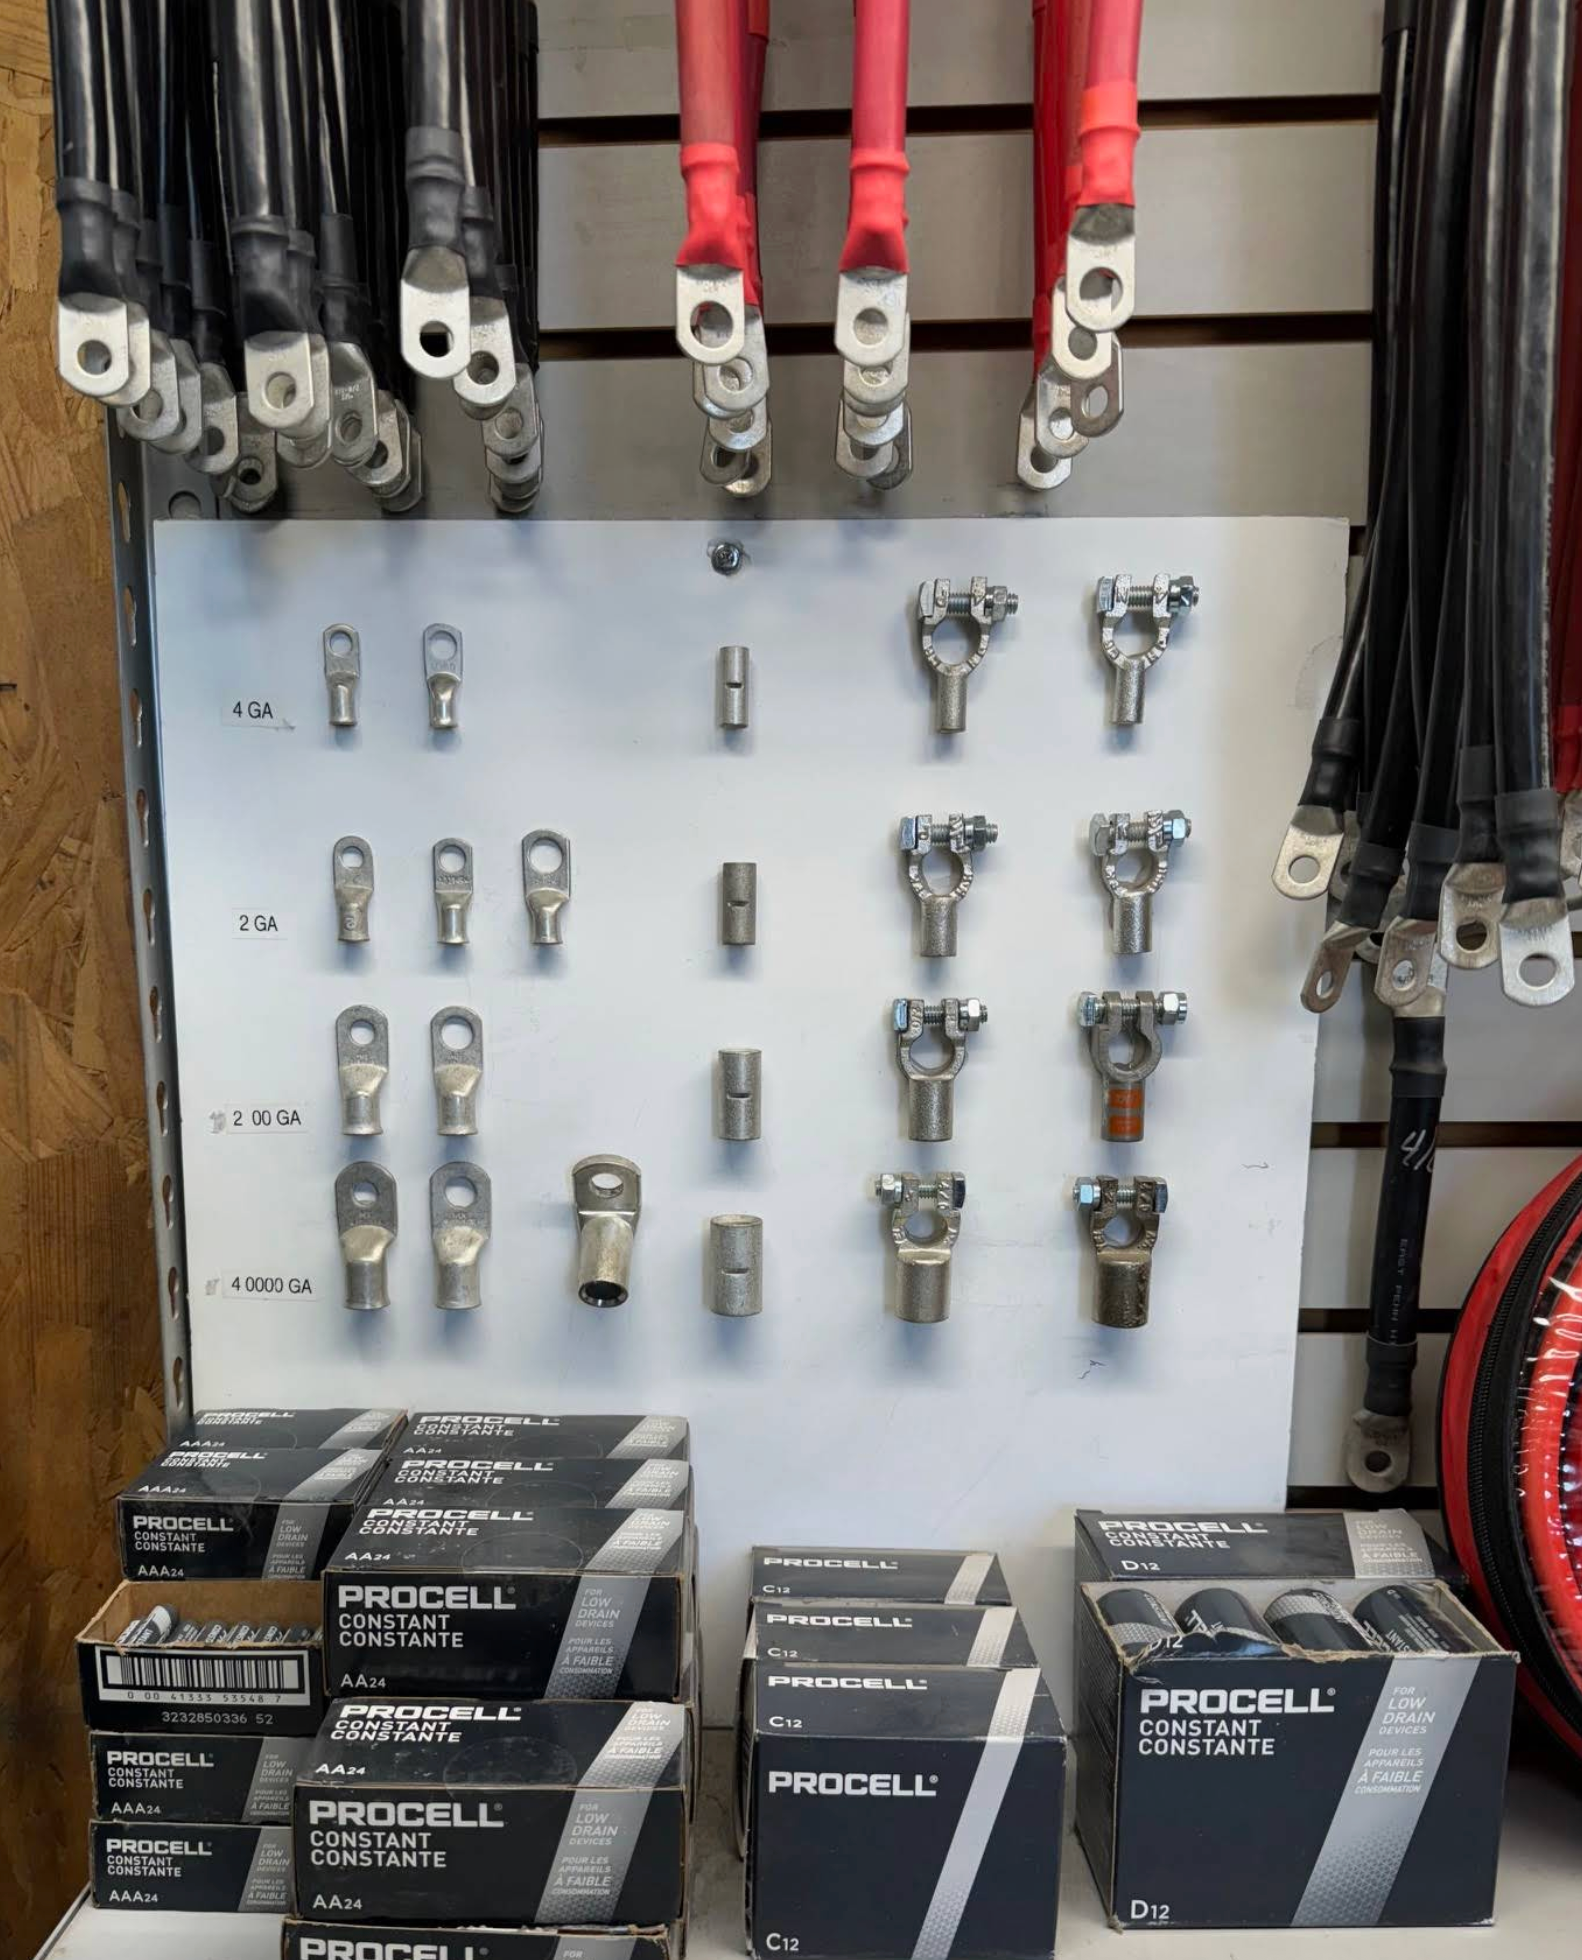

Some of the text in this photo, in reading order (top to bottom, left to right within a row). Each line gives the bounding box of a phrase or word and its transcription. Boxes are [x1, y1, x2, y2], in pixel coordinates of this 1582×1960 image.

[232, 701, 273, 719] 4 GA
[239, 915, 278, 932] 2 GA
[233, 1109, 302, 1126] 2 00 GA
[231, 1276, 313, 1294] 4 0000 GA
[419, 1415, 560, 1426] PROCELL
[413, 1429, 514, 1437] CONSTANTE
[179, 1440, 226, 1448] AAA24
[169, 1451, 266, 1460] PROCELL
[402, 1460, 554, 1471] PROCELL
[394, 1476, 504, 1485] CONSTANTE
[138, 1485, 187, 1494] AAA24
[383, 1498, 425, 1506] AA24
[367, 1509, 534, 1521] PROCELL
[133, 1515, 234, 1532] PROCELL
[363, 1520, 469, 1528] CONSTANT
[1098, 1520, 1268, 1533] PROCELL
[134, 1531, 197, 1543] CONSTANT
[359, 1527, 480, 1536] CONSTANTE
[1105, 1532, 1209, 1541] CONSTANT
[134, 1541, 205, 1553] CONSTANTE
[1109, 1539, 1231, 1549] CONSTANTE
[345, 1553, 391, 1561] AA24
[763, 1557, 898, 1570] PROCELL
[1121, 1560, 1160, 1571] D12
[137, 1564, 184, 1577] AAA24
[762, 1584, 790, 1594] C12
[338, 1585, 516, 1610] PROCELL
[581, 1597, 612, 1608] LOW
[577, 1609, 620, 1620] DRAIN
[338, 1613, 451, 1631] CONSTANT
[575, 1620, 615, 1628] DEVICES
[766, 1614, 913, 1628] PROCELL
[338, 1631, 464, 1649] CONSTANTE
[767, 1646, 799, 1658] C12
[572, 1656, 615, 1667] FAIBLE
[340, 1673, 387, 1689] AA24
[768, 1675, 928, 1690] PROCELL
[1392, 1686, 1416, 1696] FOR
[1140, 1688, 1335, 1714] PROCELL
[1388, 1697, 1427, 1710] LOW
[161, 1711, 274, 1725] 3232850336 52
[339, 1704, 522, 1722] PROCELL
[1382, 1711, 1436, 1724] DRAIN
[334, 1720, 452, 1732] CONSTANT
[769, 1716, 803, 1729] C12
[1139, 1719, 1262, 1737] CONSTANT
[1379, 1725, 1427, 1736] DEVICES
[330, 1731, 462, 1744] CONSTANTE
[1138, 1738, 1275, 1756] CONSTANTE
[1368, 1747, 1422, 1757] POUR LES
[107, 1751, 214, 1767] PROCELL
[263, 1760, 287, 1768] LOW
[1363, 1758, 1425, 1768] APPAREILS
[108, 1767, 174, 1778] CONSTANT
[261, 1768, 293, 1777] DRAIN
[315, 1763, 366, 1776] AA24
[108, 1777, 184, 1789] CONSTANTE
[1371, 1770, 1424, 1784] FAIBLE
[769, 1771, 937, 1797] PROCELL
[110, 1802, 162, 1815] AAA24
[579, 1803, 599, 1812] FOR
[309, 1800, 505, 1828] PROCELL
[575, 1813, 610, 1824] LOW
[571, 1825, 619, 1837] DRAIN
[310, 1830, 432, 1850] CONSTANT
[568, 1837, 612, 1846] DEVICES
[106, 1838, 213, 1856] PROCELL
[260, 1849, 284, 1858] LOW
[310, 1849, 447, 1868] CONSTANTE
[107, 1855, 173, 1866] CONSTANT
[258, 1857, 290, 1866] DRAIN
[561, 1856, 609, 1865] POUR LES
[107, 1866, 182, 1877] CONSTANTE
[566, 1876, 612, 1887] FAIBLE
[109, 1889, 158, 1902] AAA24
[312, 1894, 363, 1911] AA24
[1130, 1900, 1170, 1920] D12
[766, 1933, 800, 1952] C12
